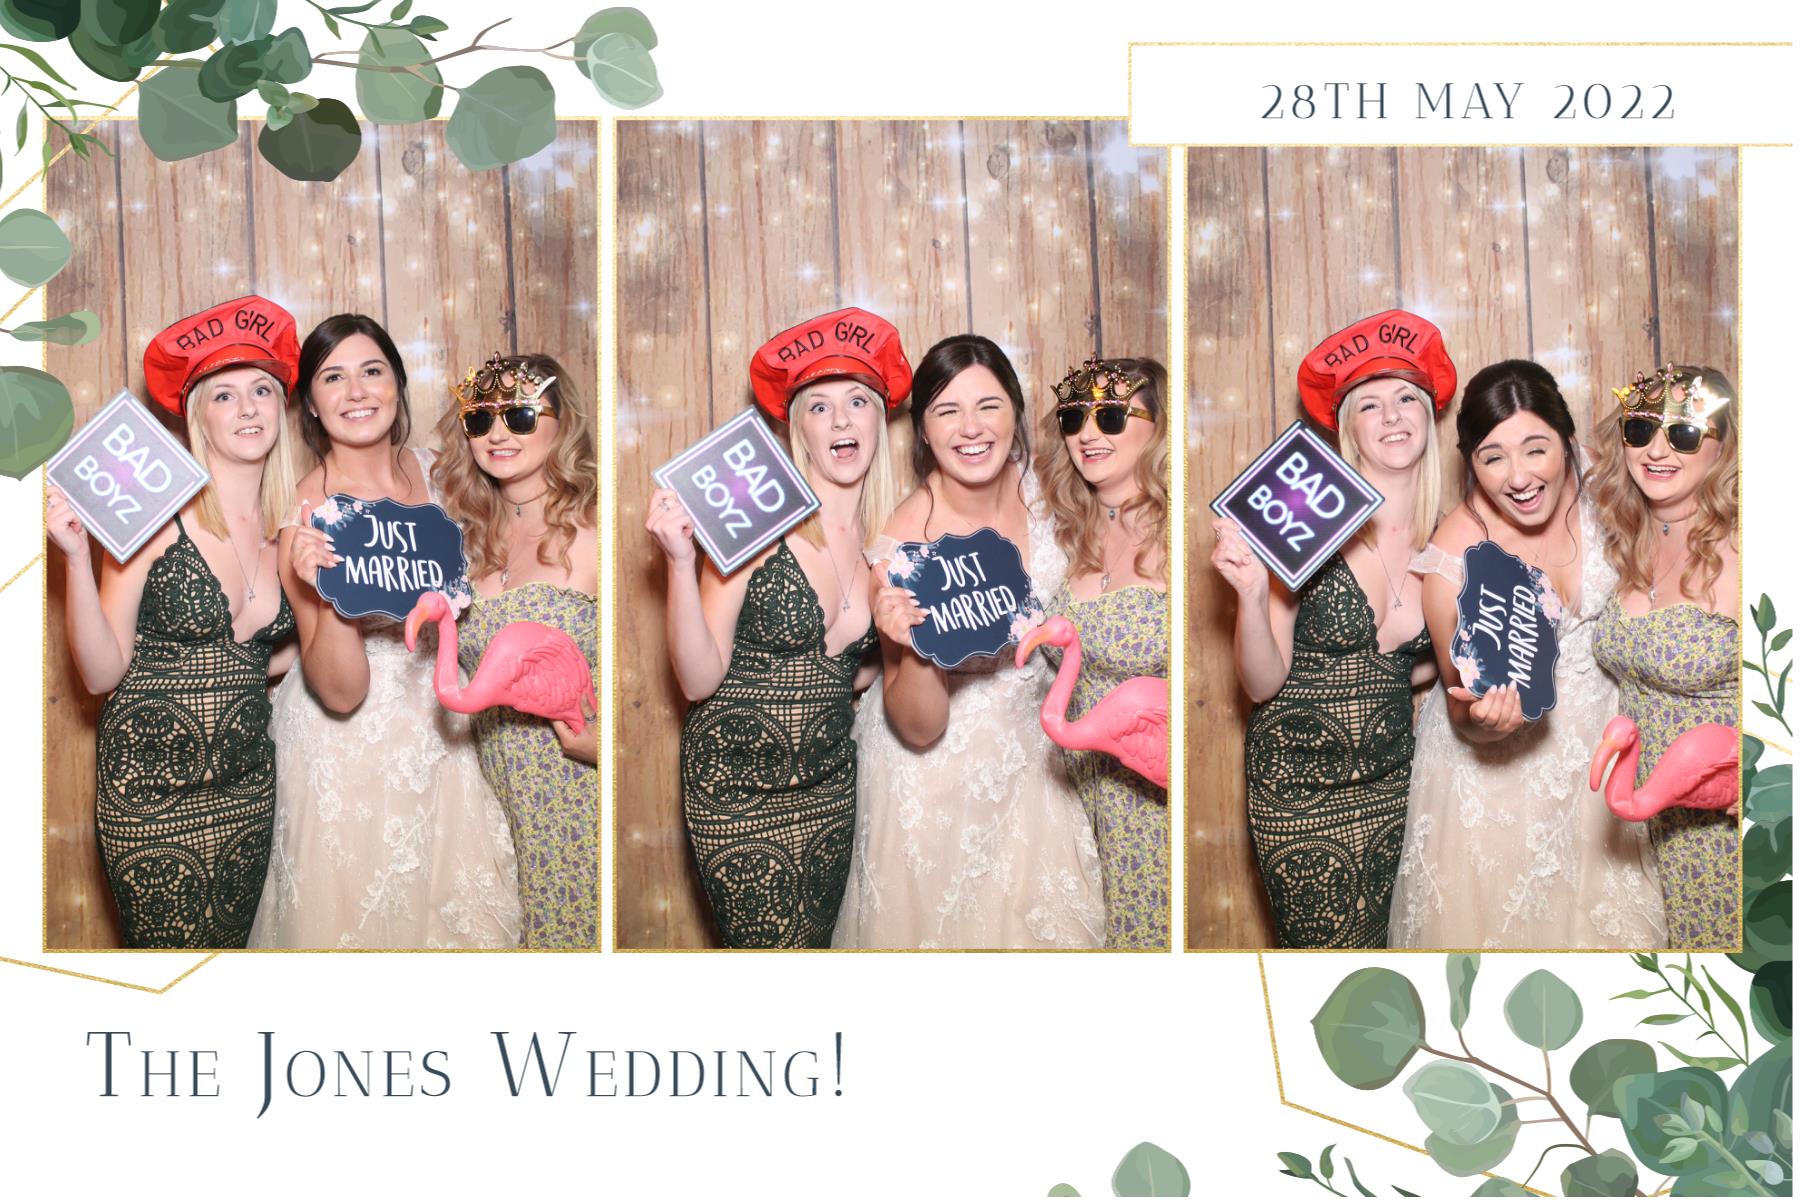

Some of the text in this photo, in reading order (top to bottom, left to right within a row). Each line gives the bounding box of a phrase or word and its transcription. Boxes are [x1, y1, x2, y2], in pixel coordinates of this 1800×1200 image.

[176, 318, 224, 350] BAD
[777, 330, 825, 362] BAD
[1324, 334, 1369, 368] BAD
[73, 454, 143, 526] BOYZ
[102, 422, 172, 494] BAD
[722, 438, 786, 513] BAD
[1275, 451, 1346, 520] BAD
[363, 514, 417, 554] JUST
[691, 464, 753, 540] BOYZ
[1247, 484, 1316, 553] BOYZ
[345, 555, 444, 593] MARRIED
[931, 551, 987, 592] JUST
[929, 585, 1017, 635] MARRIED
[1472, 583, 1507, 651] JUST
[1507, 584, 1540, 690] MARRIED
